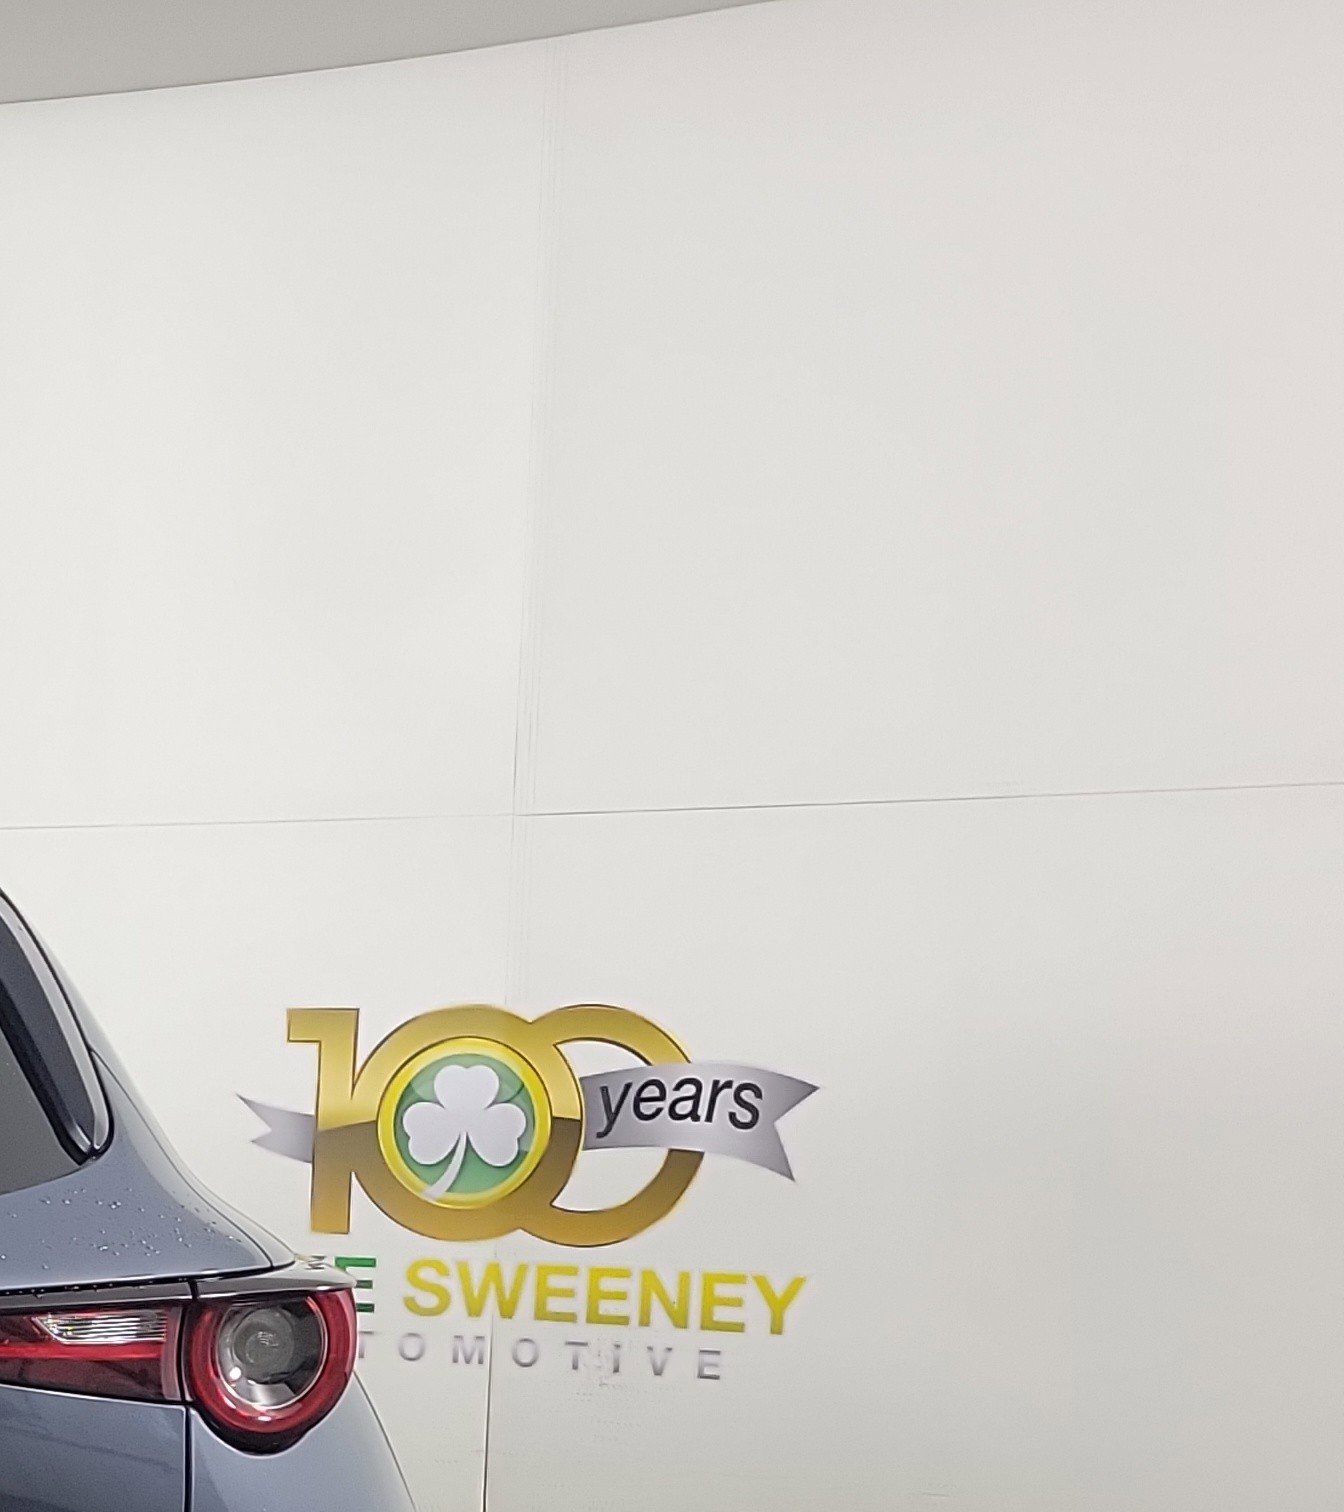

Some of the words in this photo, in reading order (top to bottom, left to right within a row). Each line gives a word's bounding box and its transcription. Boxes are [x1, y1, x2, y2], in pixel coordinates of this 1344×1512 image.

[286, 1004, 705, 1247] 100
[595, 1075, 764, 1139] years
[403, 1257, 807, 1336] SWEENEY
[358, 1330, 723, 1381] TOMOTIVE
